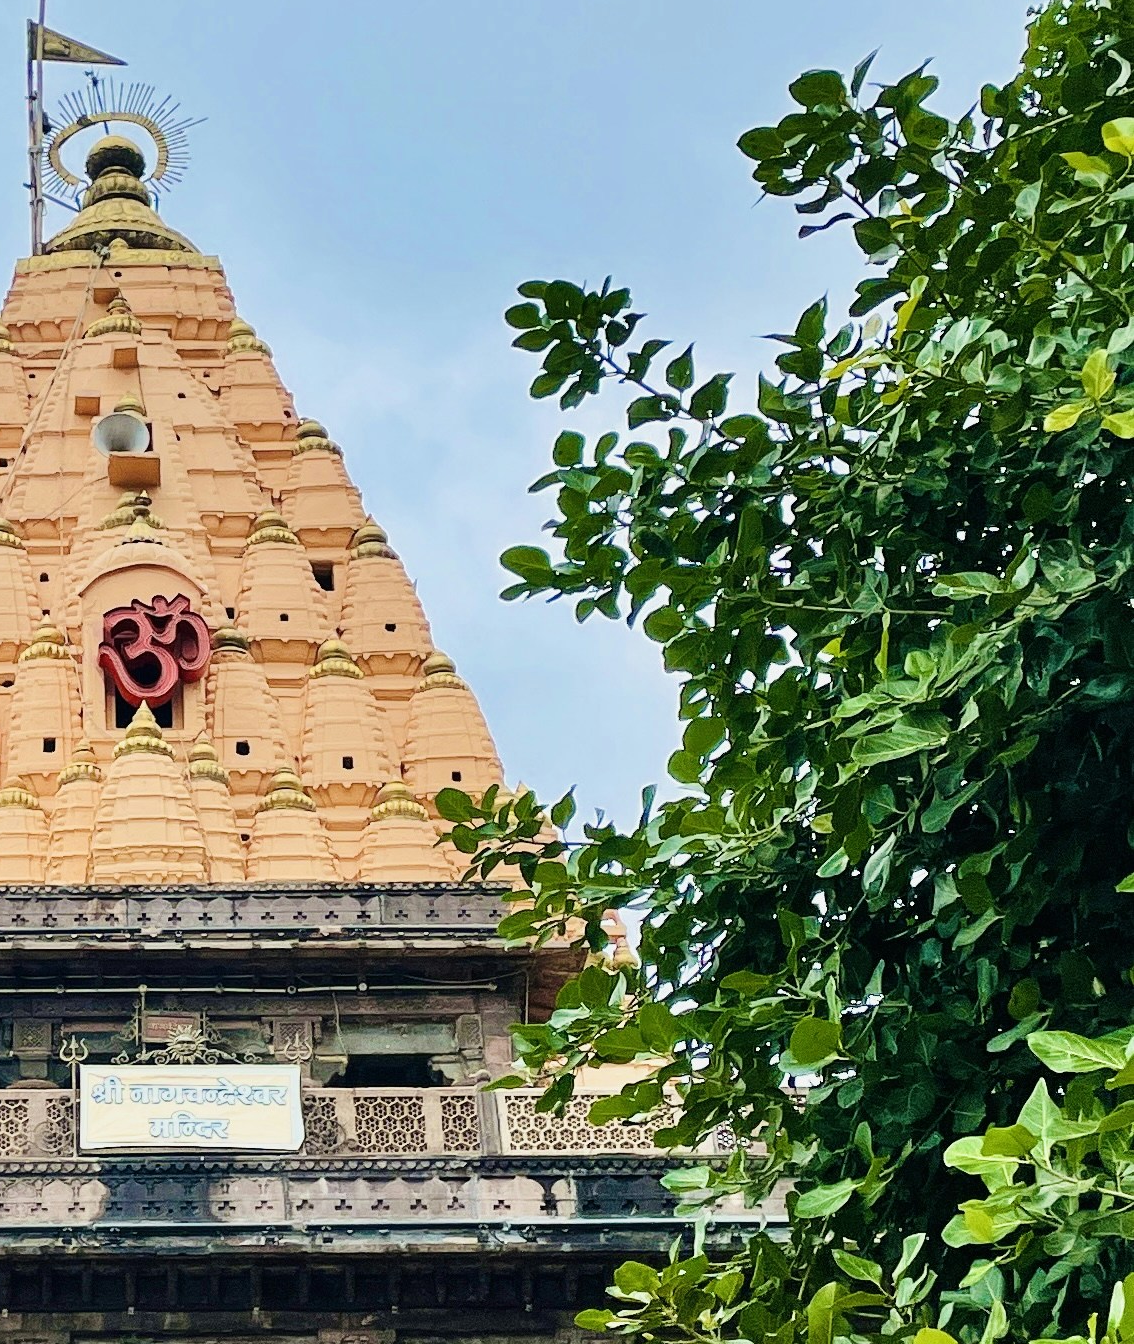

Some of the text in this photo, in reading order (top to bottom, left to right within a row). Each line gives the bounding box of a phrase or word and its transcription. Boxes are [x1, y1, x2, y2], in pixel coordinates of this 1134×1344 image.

[91, 1074, 289, 1105] श्री नागचन्द्रेश्वर
[148, 1109, 231, 1139] मन्दिर
